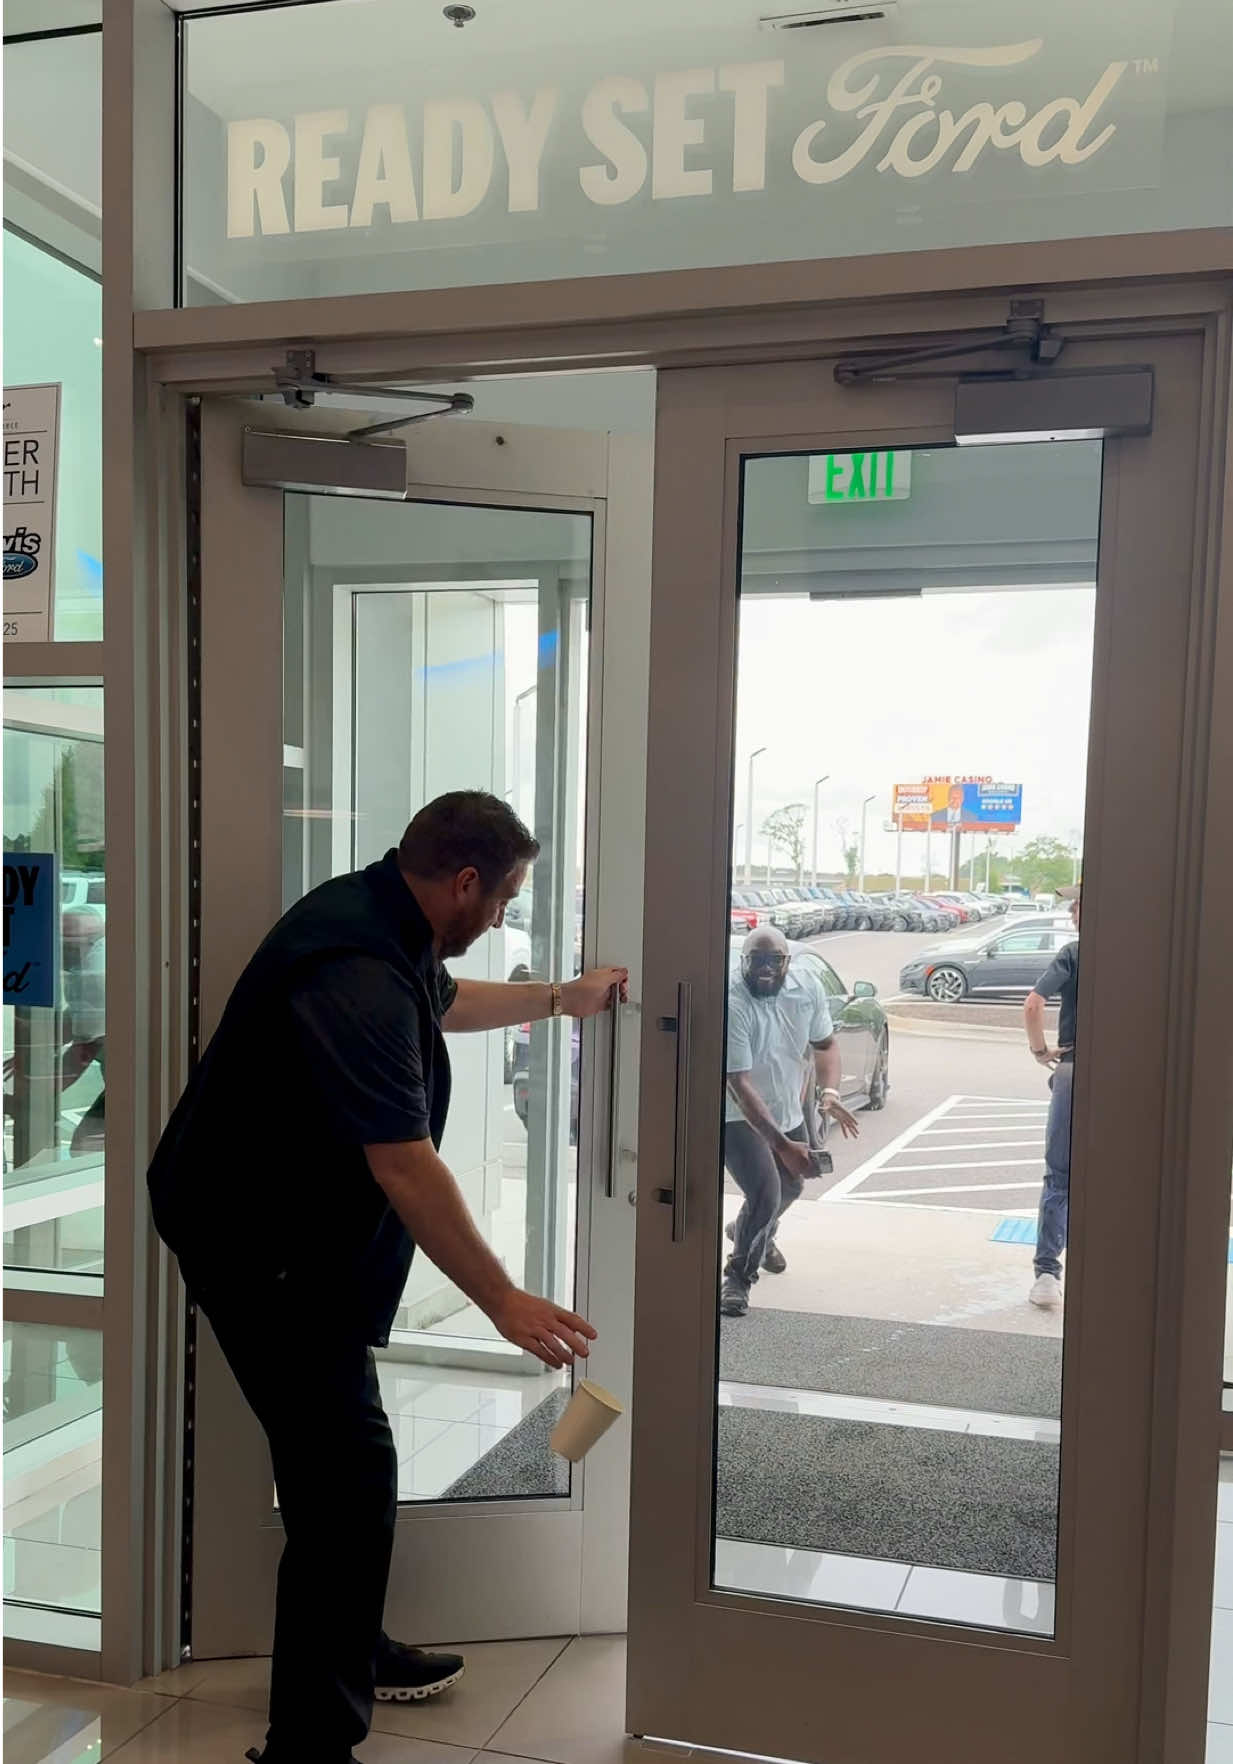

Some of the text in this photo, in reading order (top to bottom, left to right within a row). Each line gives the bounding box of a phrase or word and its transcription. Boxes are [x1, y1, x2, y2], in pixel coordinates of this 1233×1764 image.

[227, 88, 558, 239] READY
[579, 59, 784, 207] SET
[792, 38, 1127, 185] Ford
[5, 440, 39, 466] ER
[3, 470, 39, 497] TH
[921, 776, 993, 784] JAMIE CASINO
